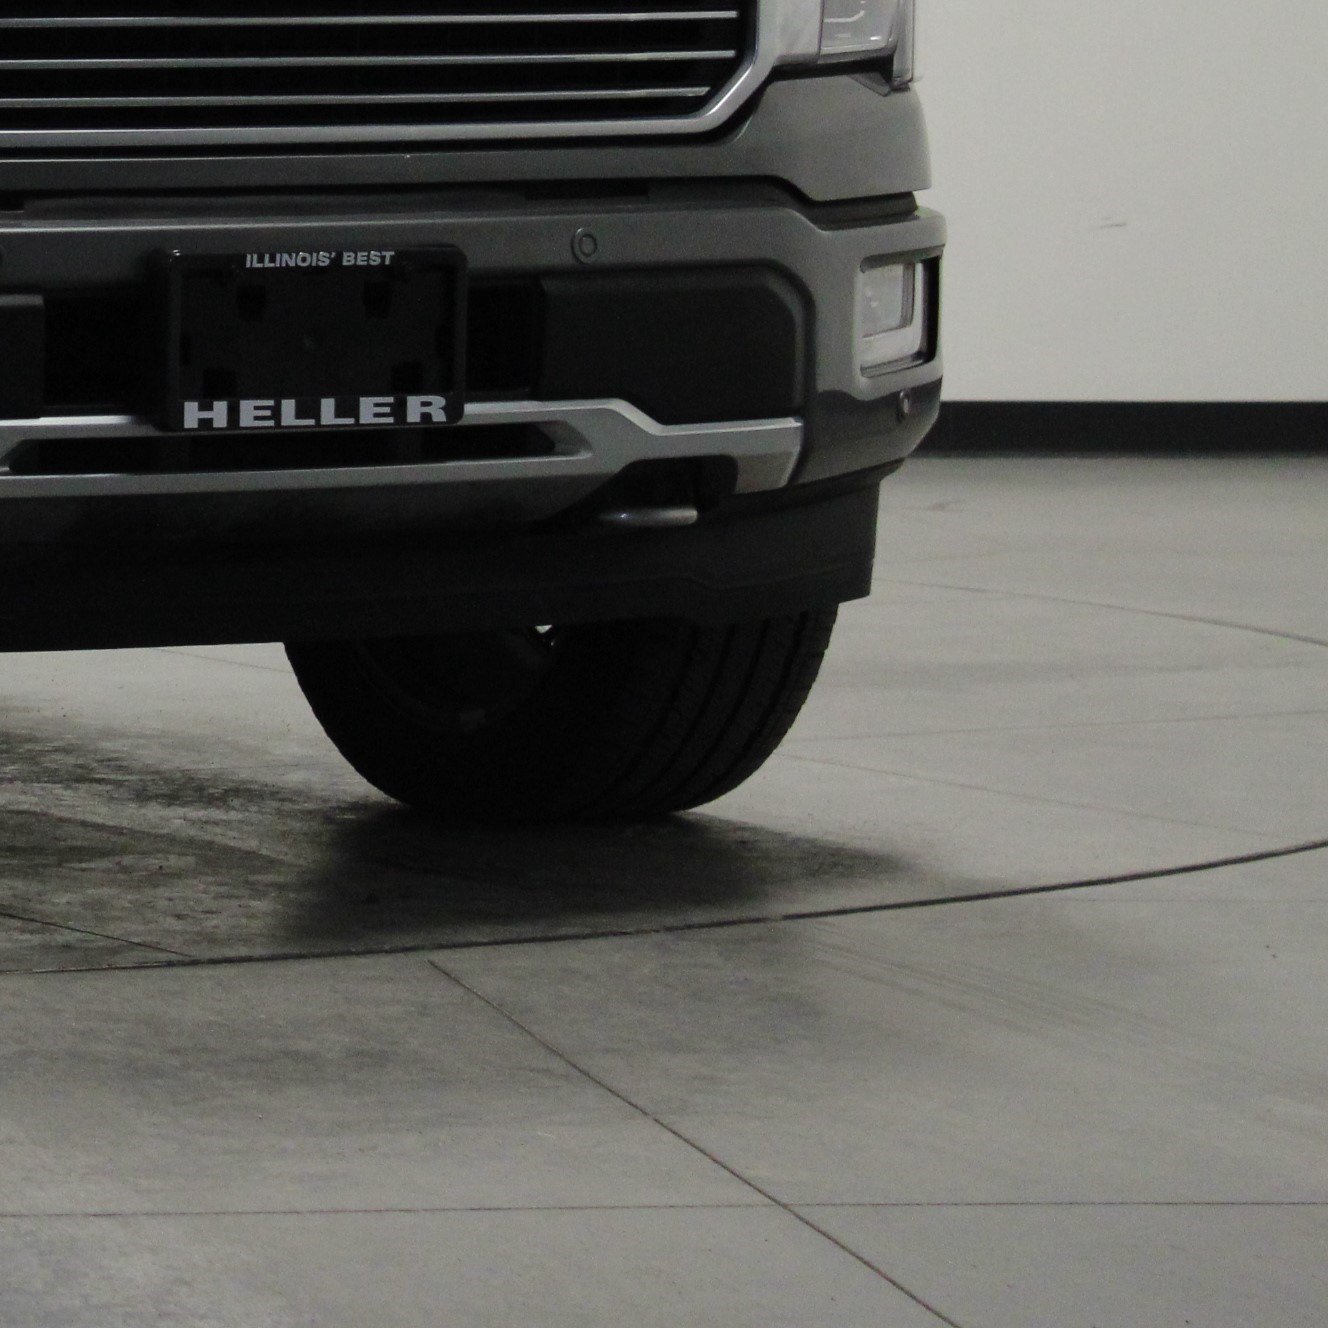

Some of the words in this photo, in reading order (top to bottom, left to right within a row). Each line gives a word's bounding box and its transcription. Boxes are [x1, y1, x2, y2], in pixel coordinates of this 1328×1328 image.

[246, 251, 336, 268] ILLINOIS'
[342, 251, 395, 266] BEST
[183, 395, 447, 429] HELLER
